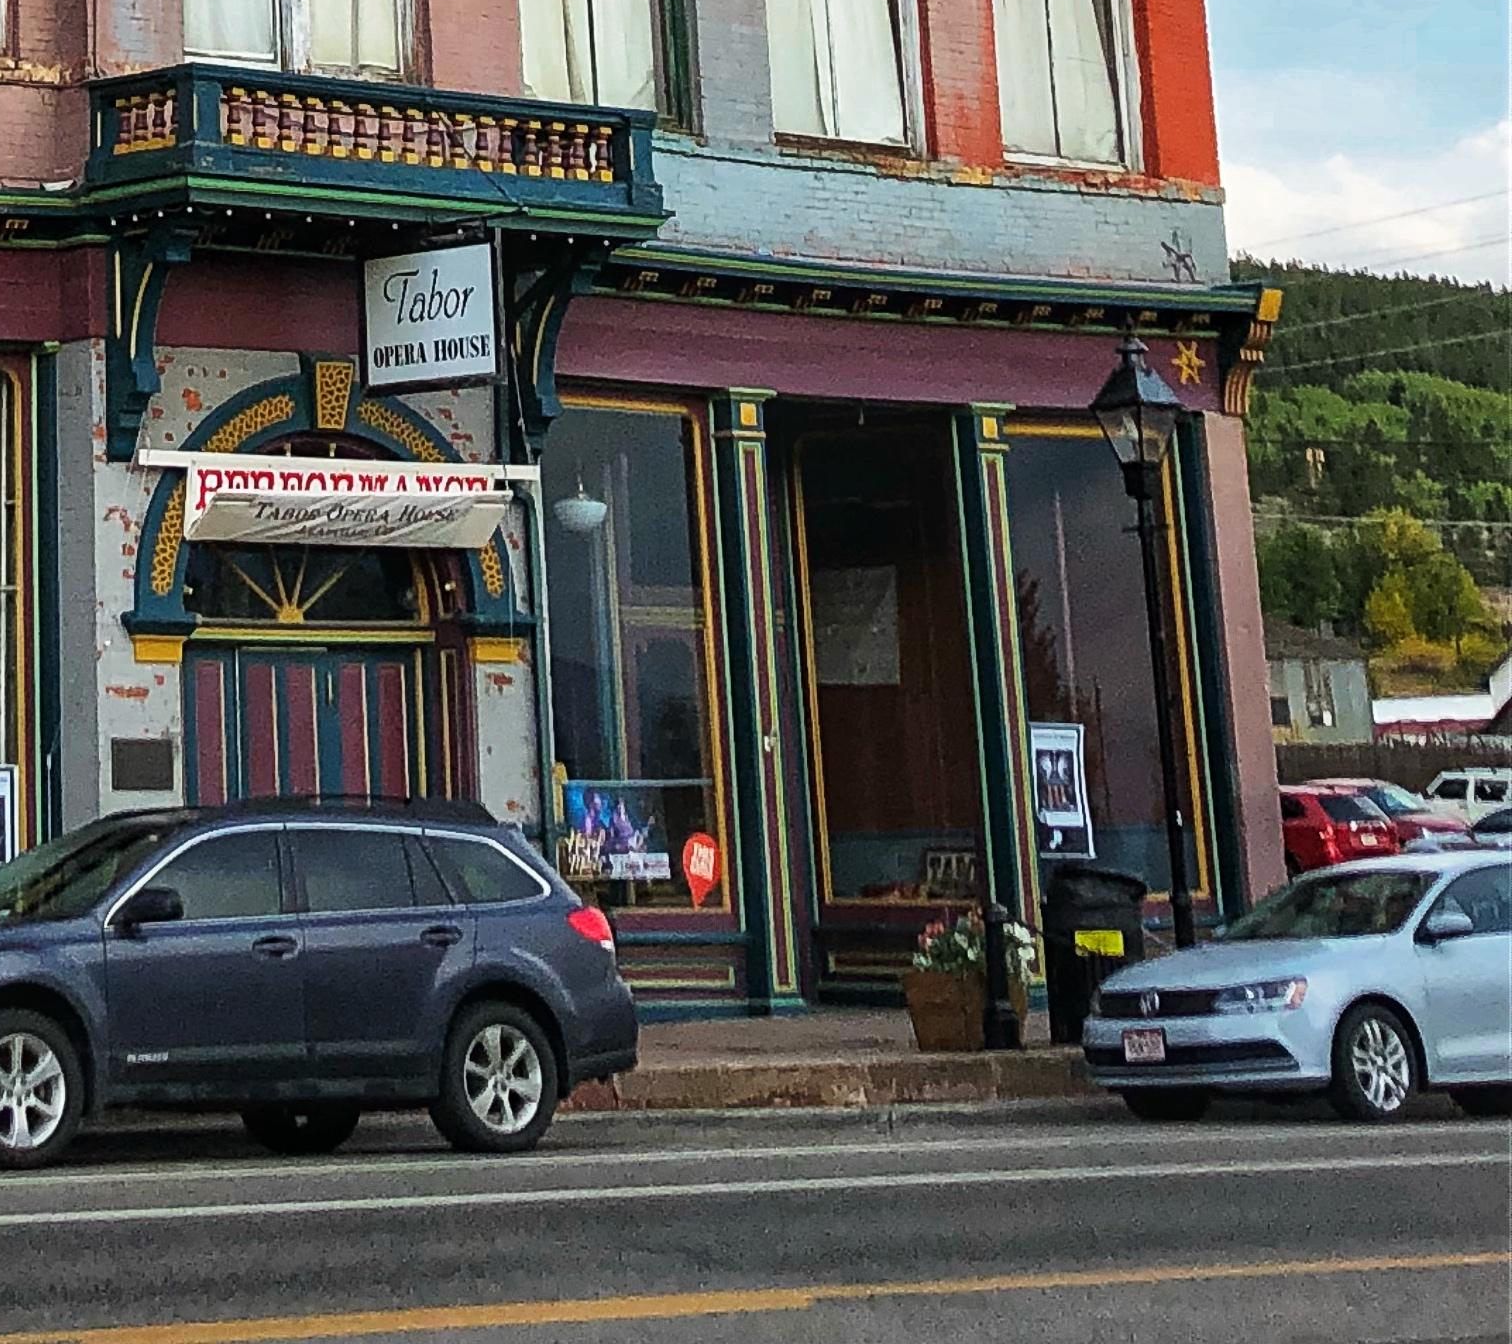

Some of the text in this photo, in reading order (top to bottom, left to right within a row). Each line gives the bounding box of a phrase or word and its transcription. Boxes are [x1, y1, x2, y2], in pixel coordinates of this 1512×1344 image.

[383, 267, 475, 326] Tabor
[373, 333, 491, 369] OPERA HOUSE
